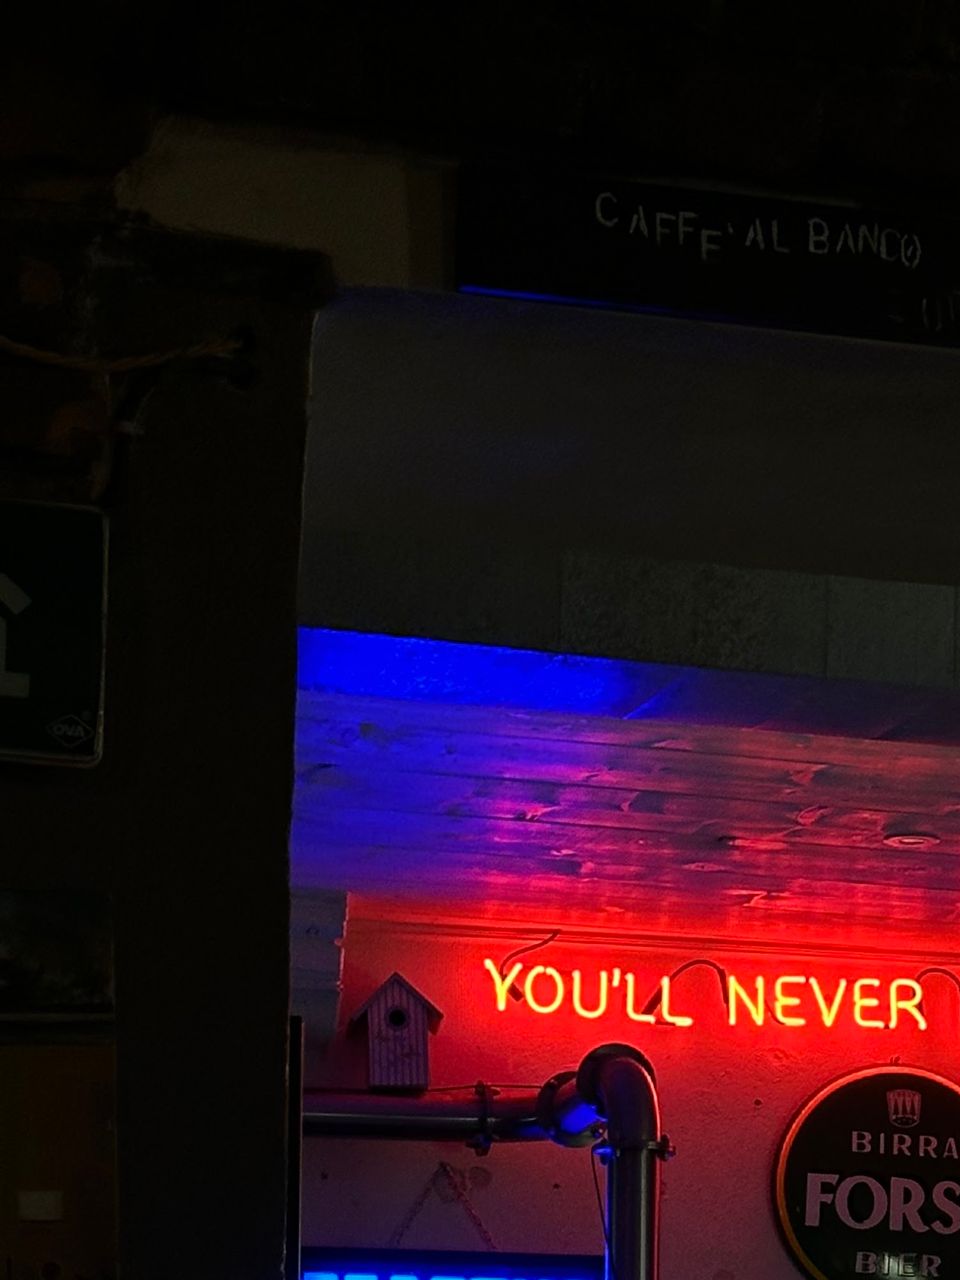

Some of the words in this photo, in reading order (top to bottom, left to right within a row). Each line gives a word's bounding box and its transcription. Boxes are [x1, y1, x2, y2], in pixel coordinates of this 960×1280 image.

[744, 217, 791, 256] AL
[484, 958, 694, 1027] YOU'LL
[728, 975, 927, 1031] NEVER
[850, 1130, 960, 1160] BIRRA
[854, 1250, 943, 1279] BIER
